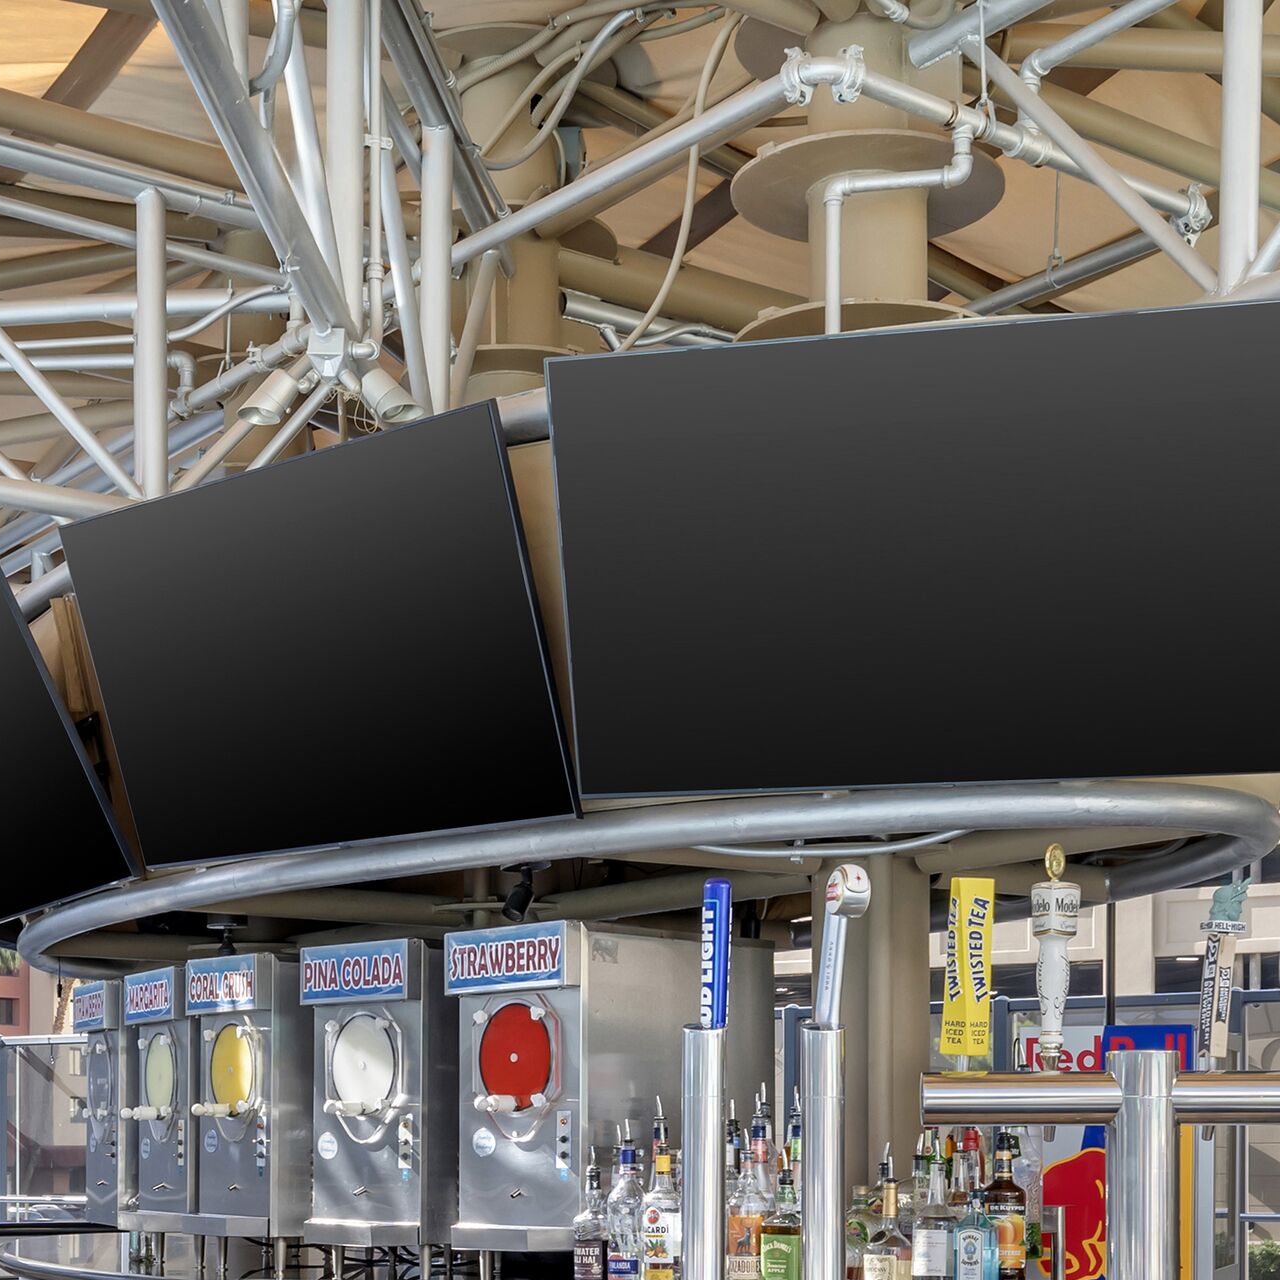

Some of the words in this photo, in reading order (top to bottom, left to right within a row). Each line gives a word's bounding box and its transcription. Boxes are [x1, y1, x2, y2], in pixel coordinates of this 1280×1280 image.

[947, 897, 960, 929] TEA
[967, 896, 991, 929] TEA
[1032, 898, 1051, 913] odelo
[450, 935, 561, 980] STRAWBERRY
[701, 906, 715, 983] LIGHT
[303, 957, 339, 992] PINA
[340, 953, 404, 990] COLADA
[947, 928, 964, 1003] TWISTED
[968, 930, 990, 1004] TWISTED
[127, 978, 169, 1015] MARGARITA
[189, 972, 220, 1003] CORAL
[221, 968, 254, 1001] CRUSH
[74, 989, 104, 1021] TRAWBERRY
[700, 986, 714, 1029] UD
[944, 1020, 966, 1029] HARD
[945, 1028, 964, 1037] ICED
[970, 1021, 988, 1029] HARD
[970, 1029, 986, 1037] ICED
[946, 1037, 962, 1045] TEA
[972, 1037, 985, 1045] TEA
[1025, 1035, 1102, 1072] Red
[962, 1233, 979, 1242] BOMBAY
